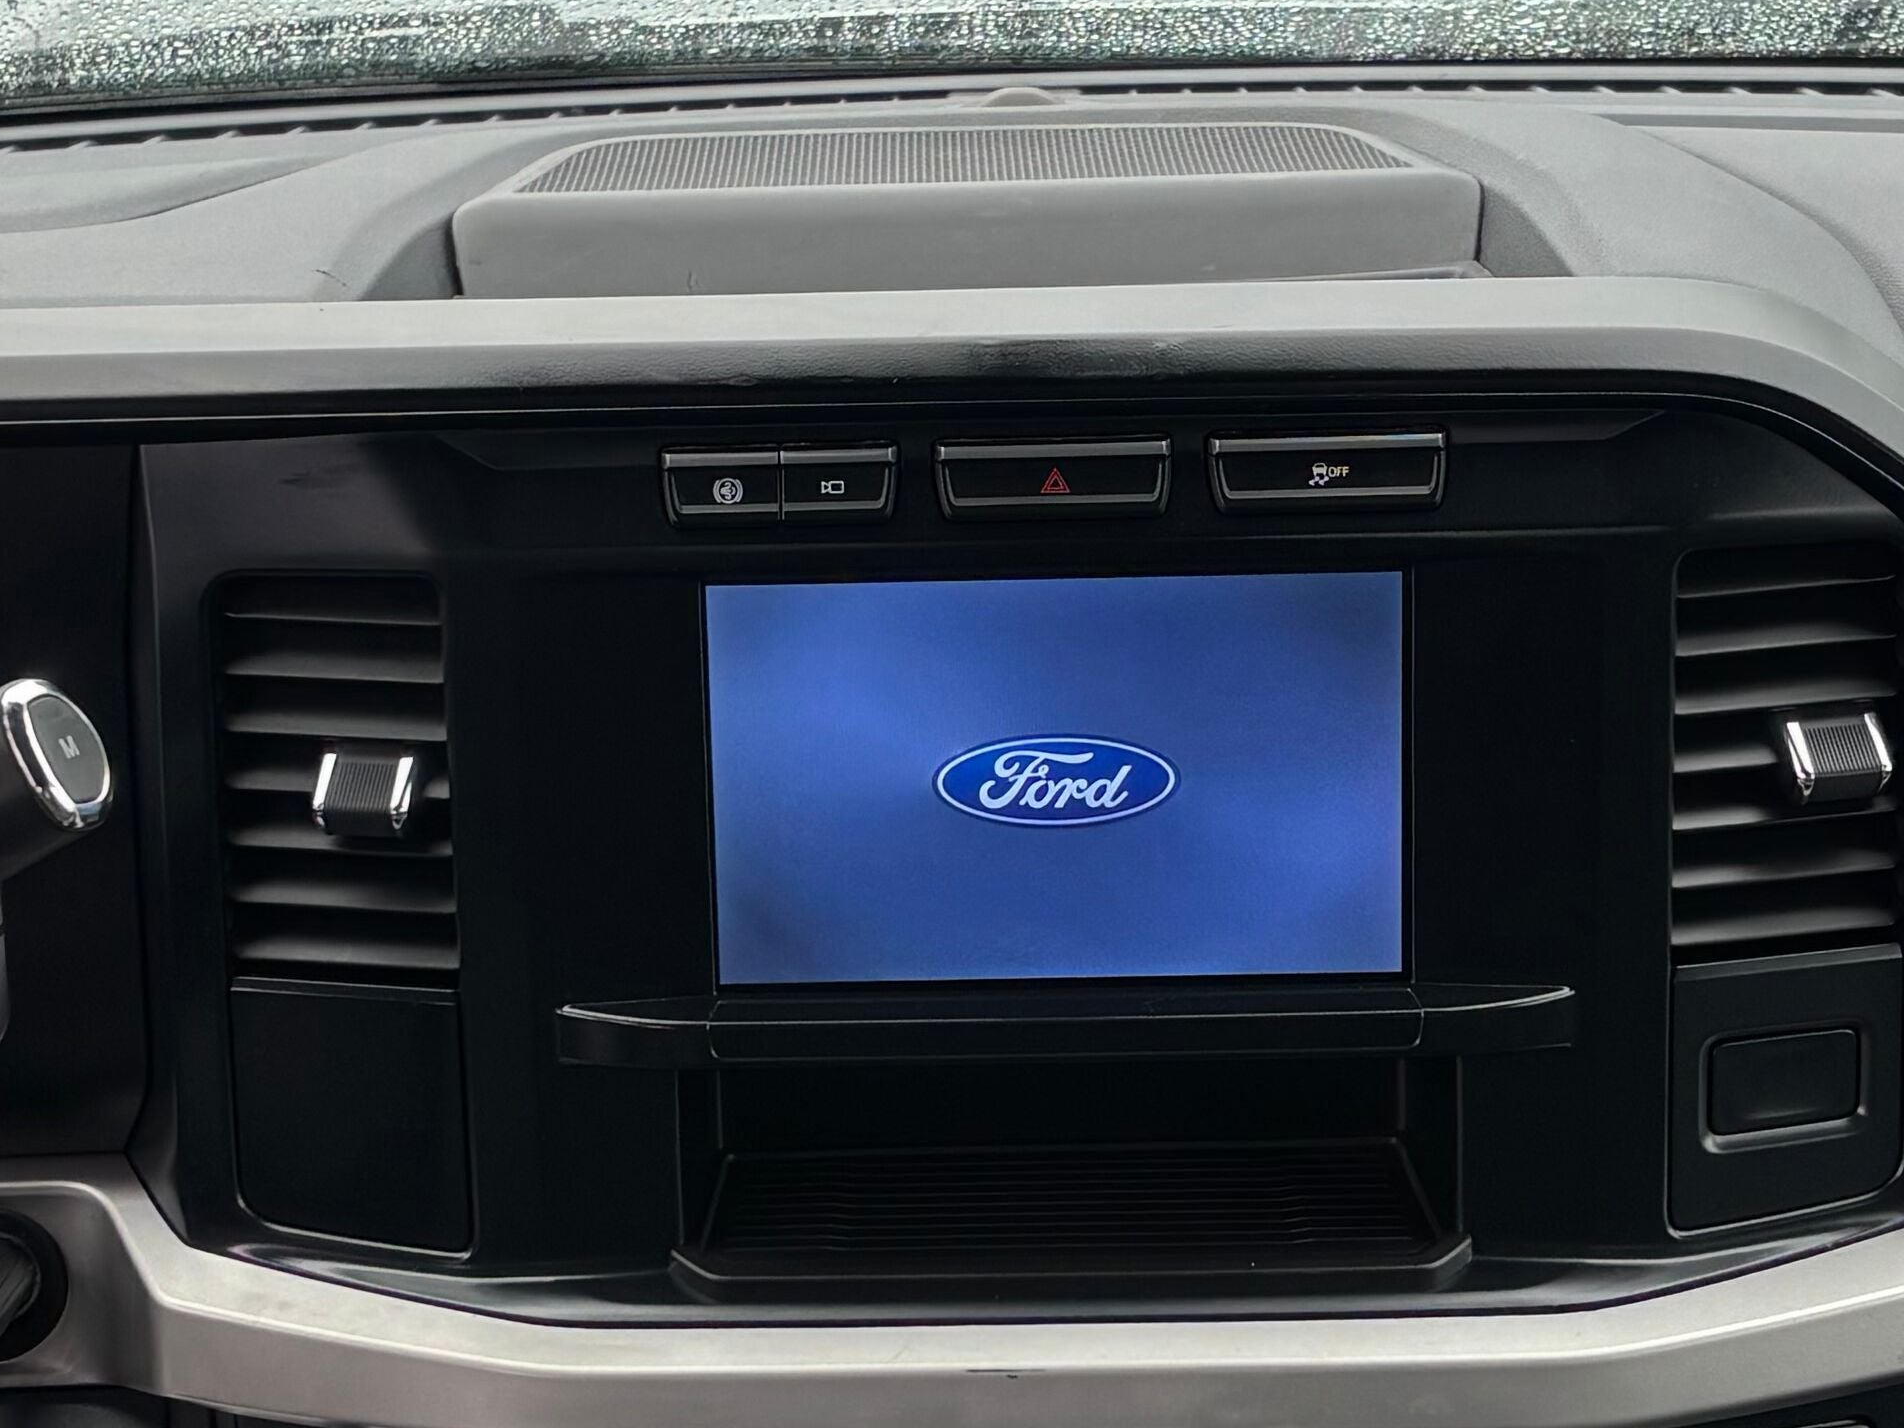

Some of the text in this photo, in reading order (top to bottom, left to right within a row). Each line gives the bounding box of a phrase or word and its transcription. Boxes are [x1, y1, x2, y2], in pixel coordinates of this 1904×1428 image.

[1328, 466, 1350, 478] OFF
[58, 735, 81, 761] M
[979, 750, 1132, 809] Ford
